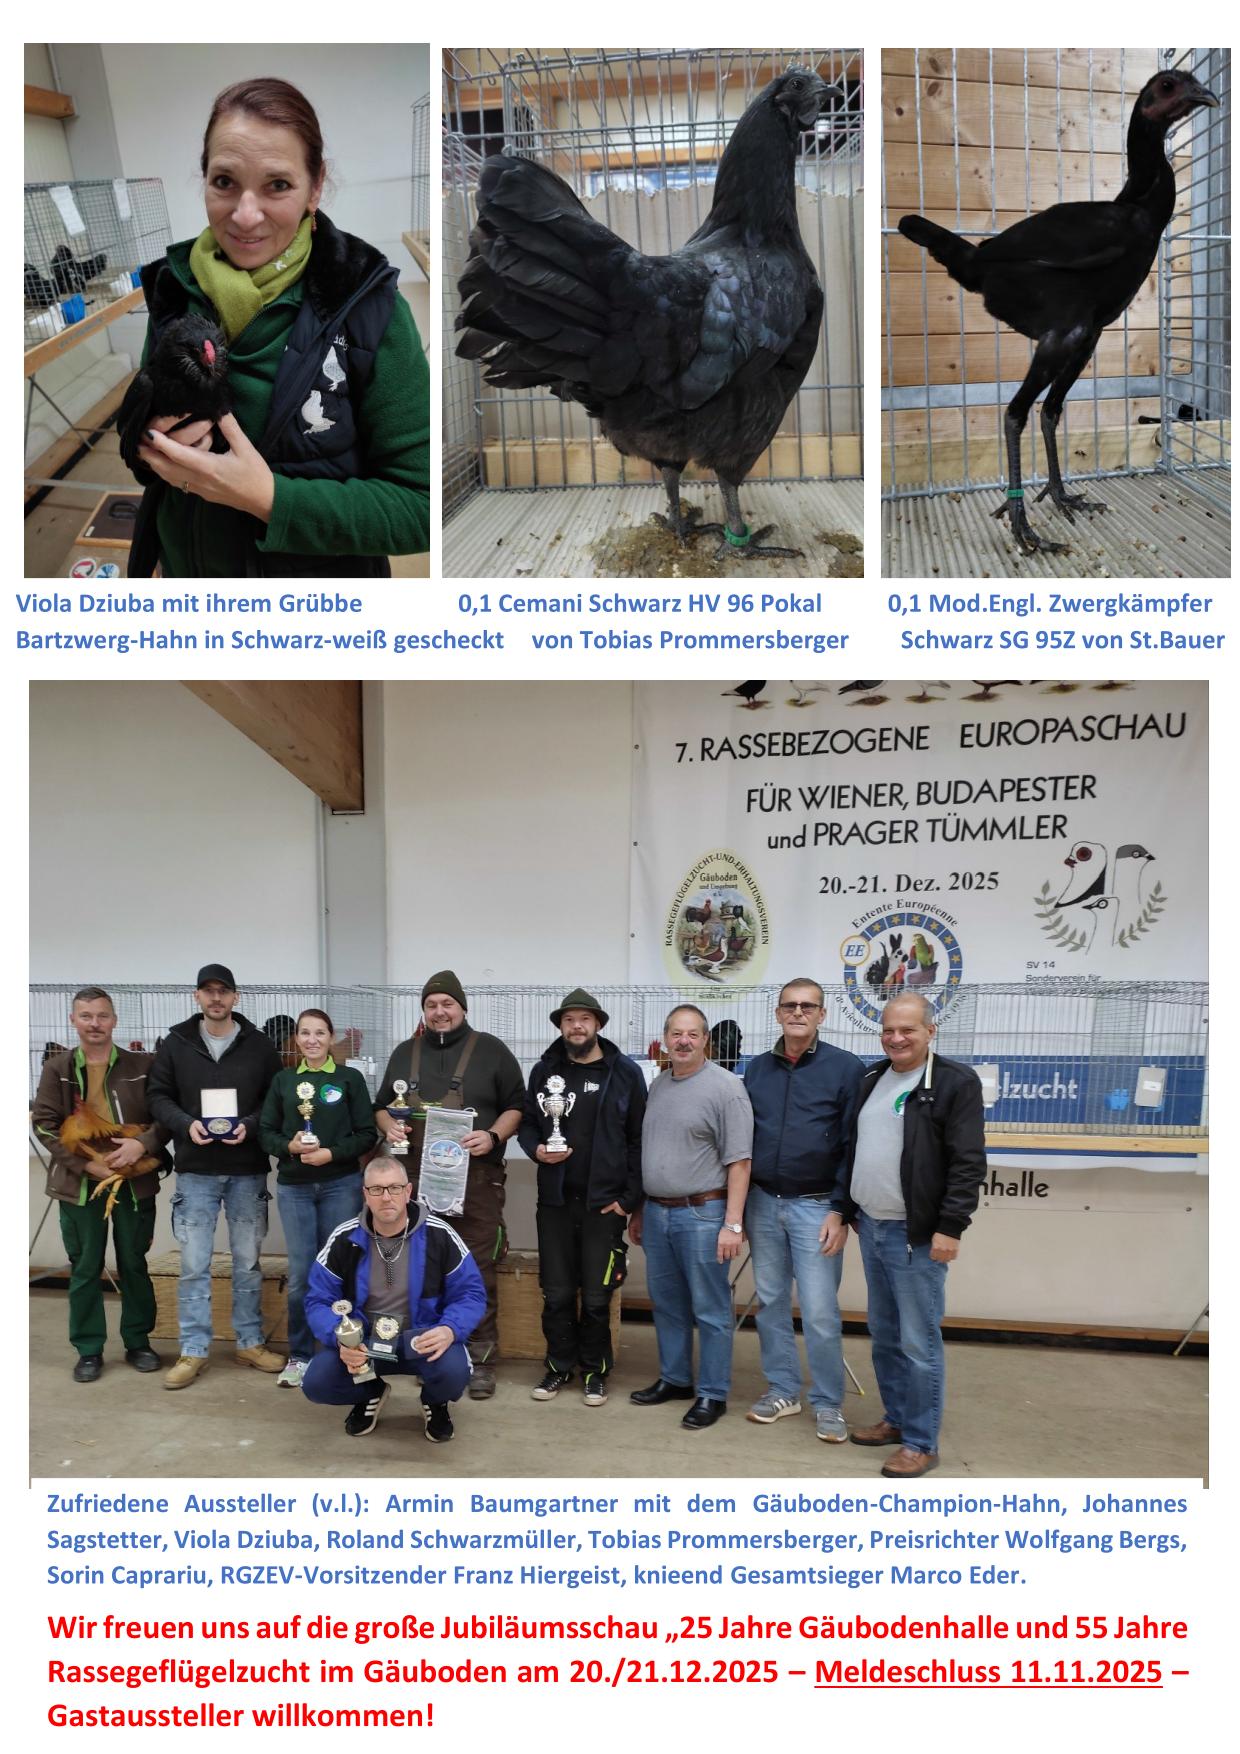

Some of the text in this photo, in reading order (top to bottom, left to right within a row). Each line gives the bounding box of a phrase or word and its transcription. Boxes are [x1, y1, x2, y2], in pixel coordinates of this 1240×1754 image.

[675, 713, 1187, 762] 7. RASSEBEZOGENE EUROPASCHAU
[746, 775, 1097, 813] FÜR WIENER, BUDAPESTER
[767, 812, 1068, 849] und PRAGER TÜMMLER
[700, 872, 738, 882] Gäuboden
[819, 871, 999, 894] 20.-21. Dez. 2025
[852, 899, 958, 929] Entente Européenne
[845, 944, 866, 957] EE
[1026, 961, 1055, 969] SV 14
[1025, 974, 1101, 982] Sonderverein für
[998, 1072, 1079, 1099] lzucht
